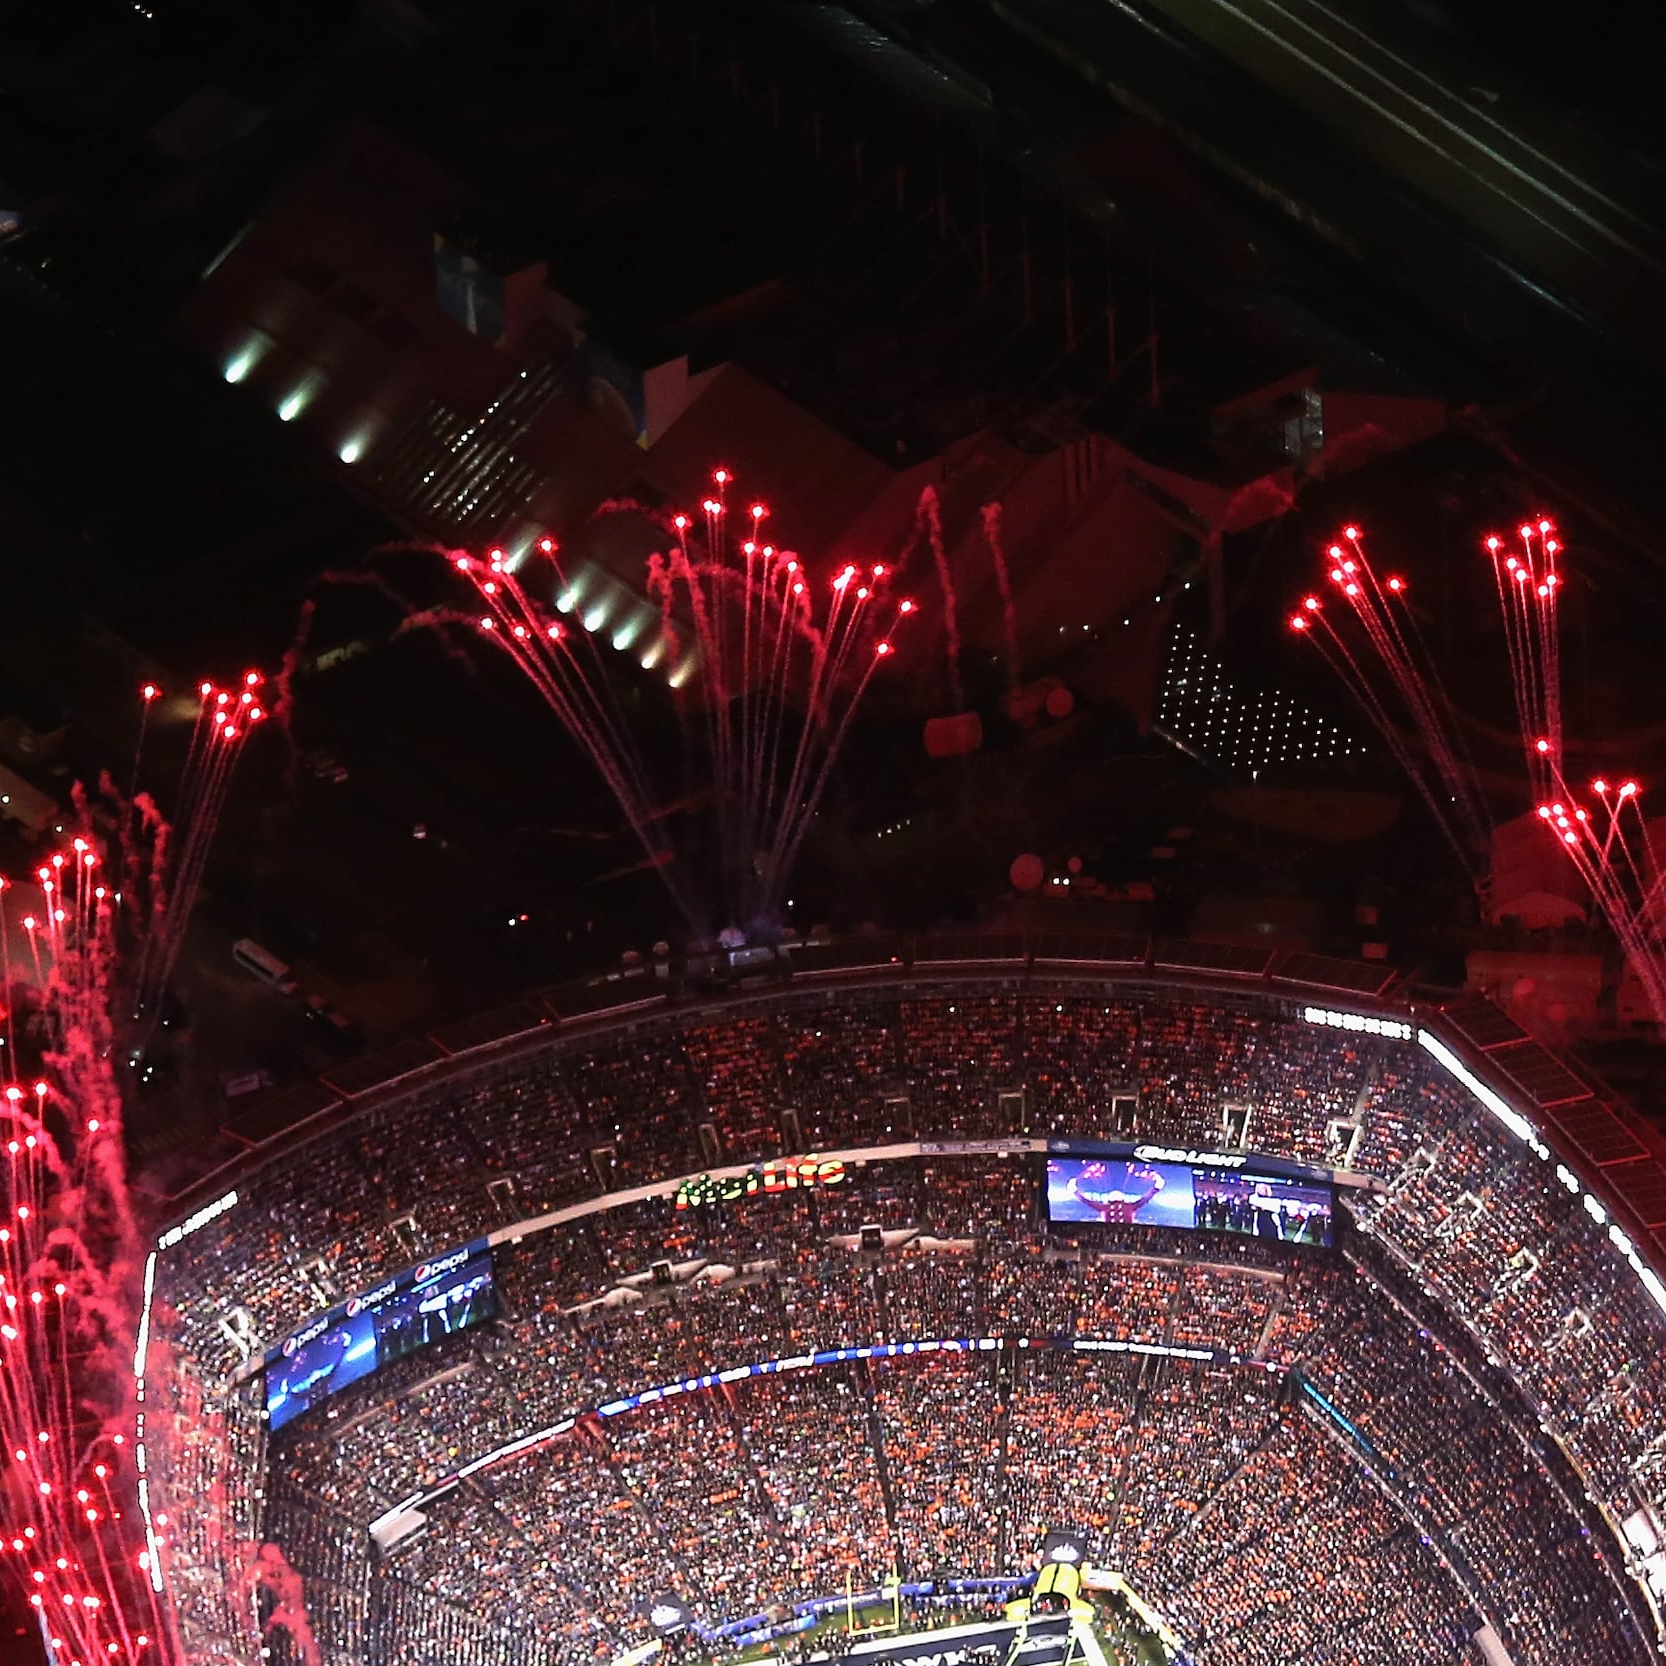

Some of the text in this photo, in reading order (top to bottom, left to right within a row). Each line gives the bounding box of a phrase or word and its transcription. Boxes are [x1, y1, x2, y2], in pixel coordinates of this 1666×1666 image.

[431, 1248, 469, 1276] pepsi
[361, 1280, 397, 1310] pepsi
[296, 1316, 330, 1349] pepsi
